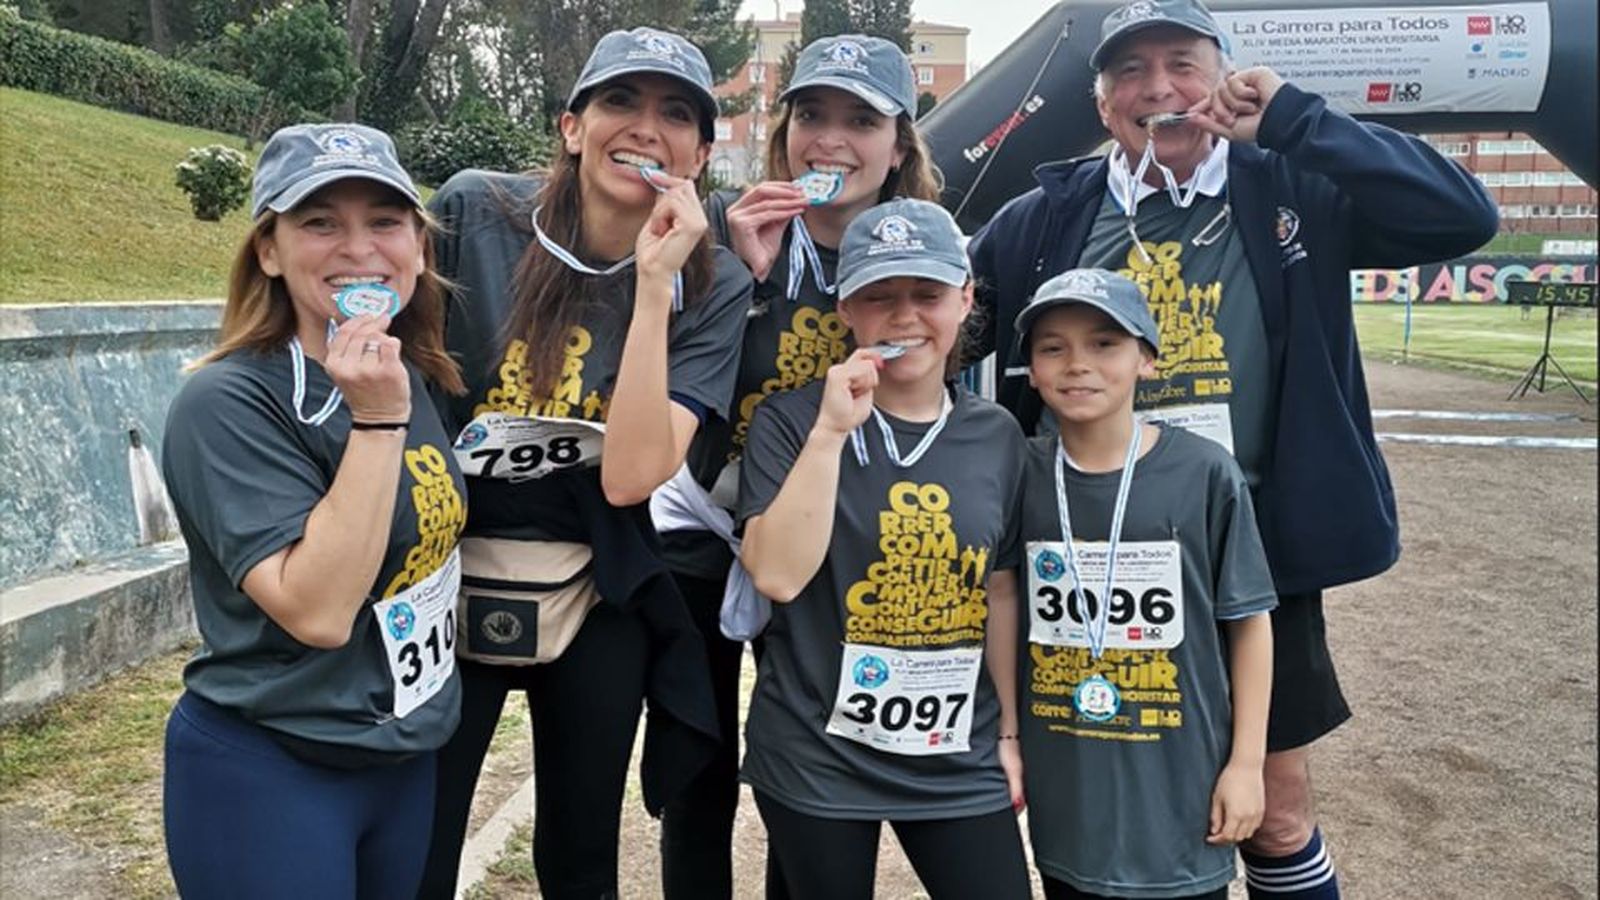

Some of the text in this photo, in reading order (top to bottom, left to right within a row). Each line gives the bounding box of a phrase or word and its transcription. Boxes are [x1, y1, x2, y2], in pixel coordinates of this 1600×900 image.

[1232, 16, 1450, 36] La Carrera para Todos
[1269, 37, 1302, 46] MEDIA
[1359, 33, 1440, 44] UNIVERSITARIA
[1482, 68, 1530, 78] MADRID
[792, 307, 850, 341] CO
[404, 444, 446, 487] CO
[471, 436, 581, 476] 798
[889, 481, 950, 517] CO
[880, 510, 952, 535] RRER
[879, 529, 958, 560] COM
[886, 553, 951, 583] PETIR
[880, 573, 960, 601] MOVER
[846, 600, 988, 634] CONSEGUIR
[1037, 586, 1176, 625] 3096
[843, 692, 969, 732] 3097
